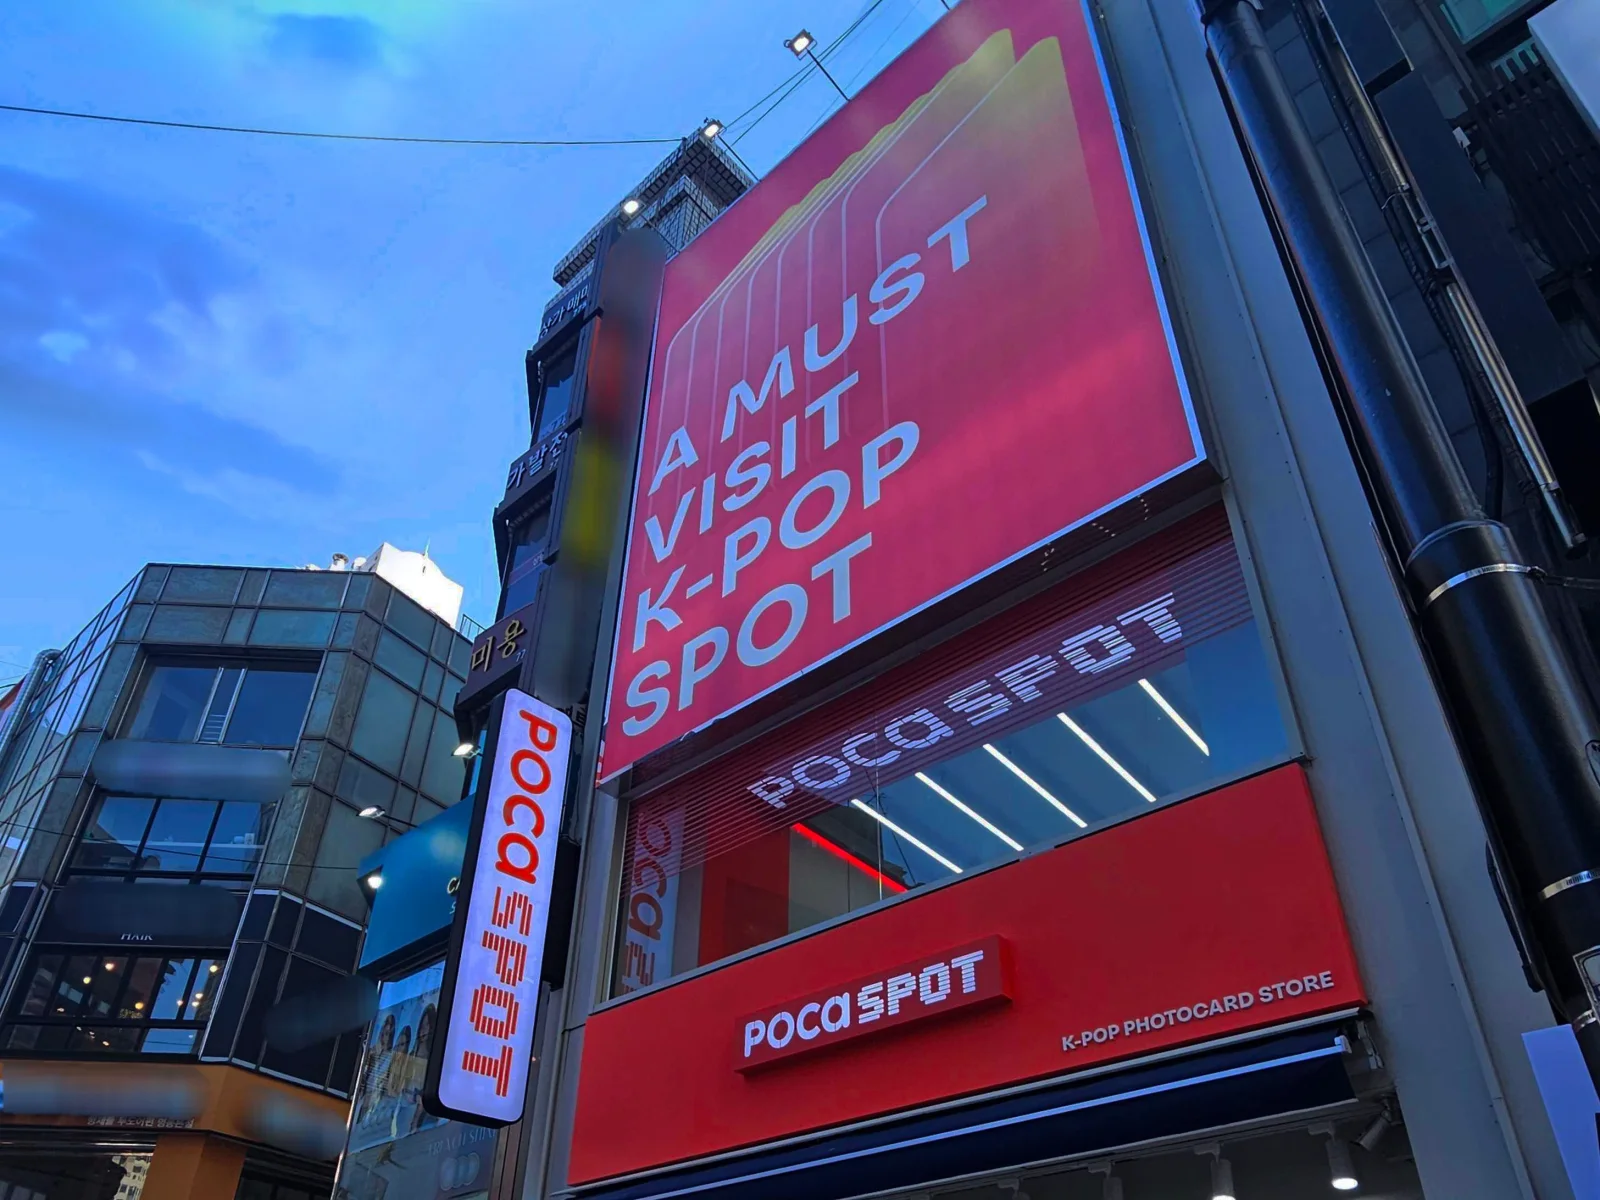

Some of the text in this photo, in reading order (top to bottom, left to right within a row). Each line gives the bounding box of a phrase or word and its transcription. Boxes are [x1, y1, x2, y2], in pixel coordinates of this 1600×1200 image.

[648, 194, 988, 497] A MUST
[632, 421, 920, 653] K-POP
[644, 370, 859, 563] VISIT
[472, 620, 525, 672] 미용
[622, 532, 873, 737] SPOT
[1061, 970, 1335, 1051] K-POP PHOTOCARD STORE
